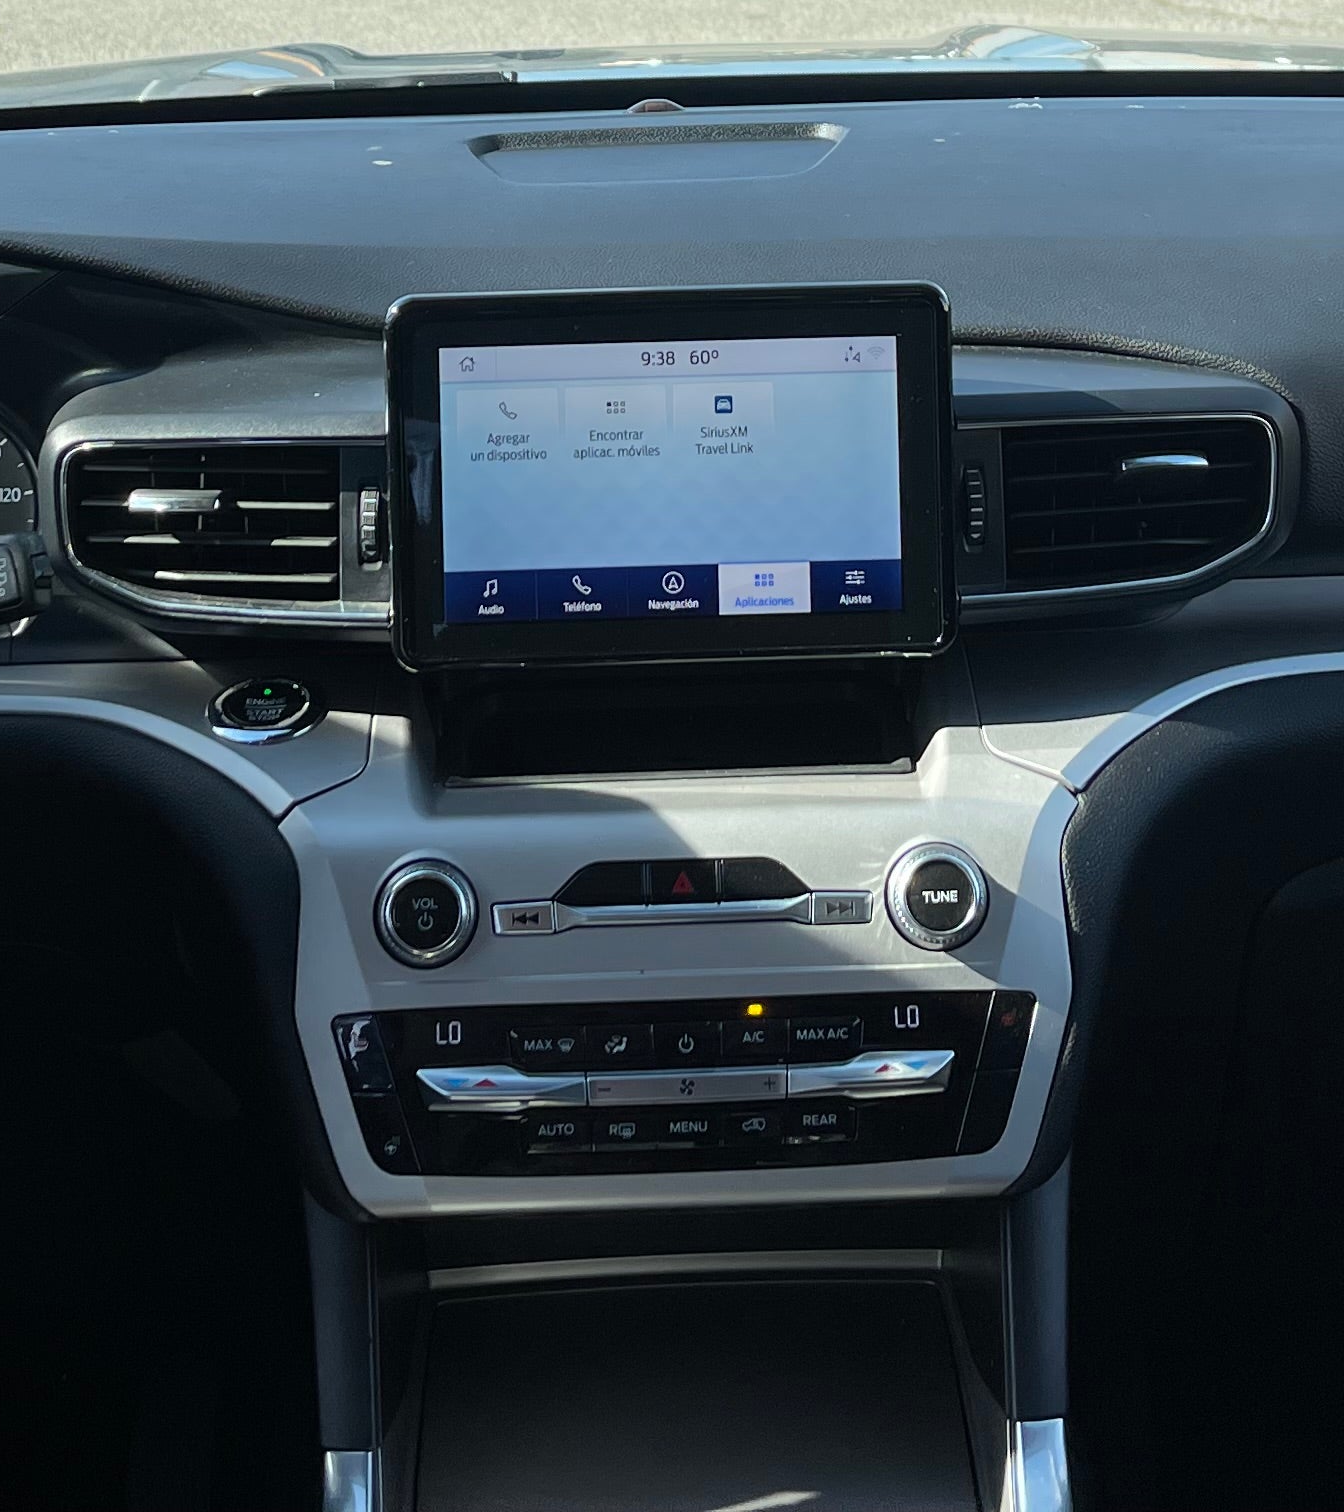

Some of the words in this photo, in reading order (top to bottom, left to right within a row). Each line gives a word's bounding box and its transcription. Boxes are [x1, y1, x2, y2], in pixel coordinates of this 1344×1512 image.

[640, 351, 675, 366] 9:38
[589, 429, 644, 442] Encontrar
[700, 426, 748, 439] SiriusXM
[487, 433, 530, 447] Agregar
[573, 446, 615, 460] aplicac.
[617, 444, 660, 458] móviles
[695, 443, 728, 455] Travel
[730, 441, 754, 454] Link
[470, 451, 485, 461] un
[487, 448, 548, 463] dispositivo
[563, 601, 602, 612] Teléfono
[648, 598, 699, 610] Navegación
[735, 595, 794, 608] Aplicaciones
[839, 594, 872, 606] Ajustes
[478, 604, 505, 615] Audio
[921, 889, 959, 904] TUNE
[412, 897, 439, 910] VOL
[742, 1030, 765, 1043] A/C
[796, 1028, 825, 1041] MAX
[827, 1027, 849, 1039] A/C
[524, 1038, 553, 1051] MAX
[802, 1113, 837, 1127] REAR
[538, 1122, 575, 1137] AUTO
[669, 1120, 708, 1134] MENU
